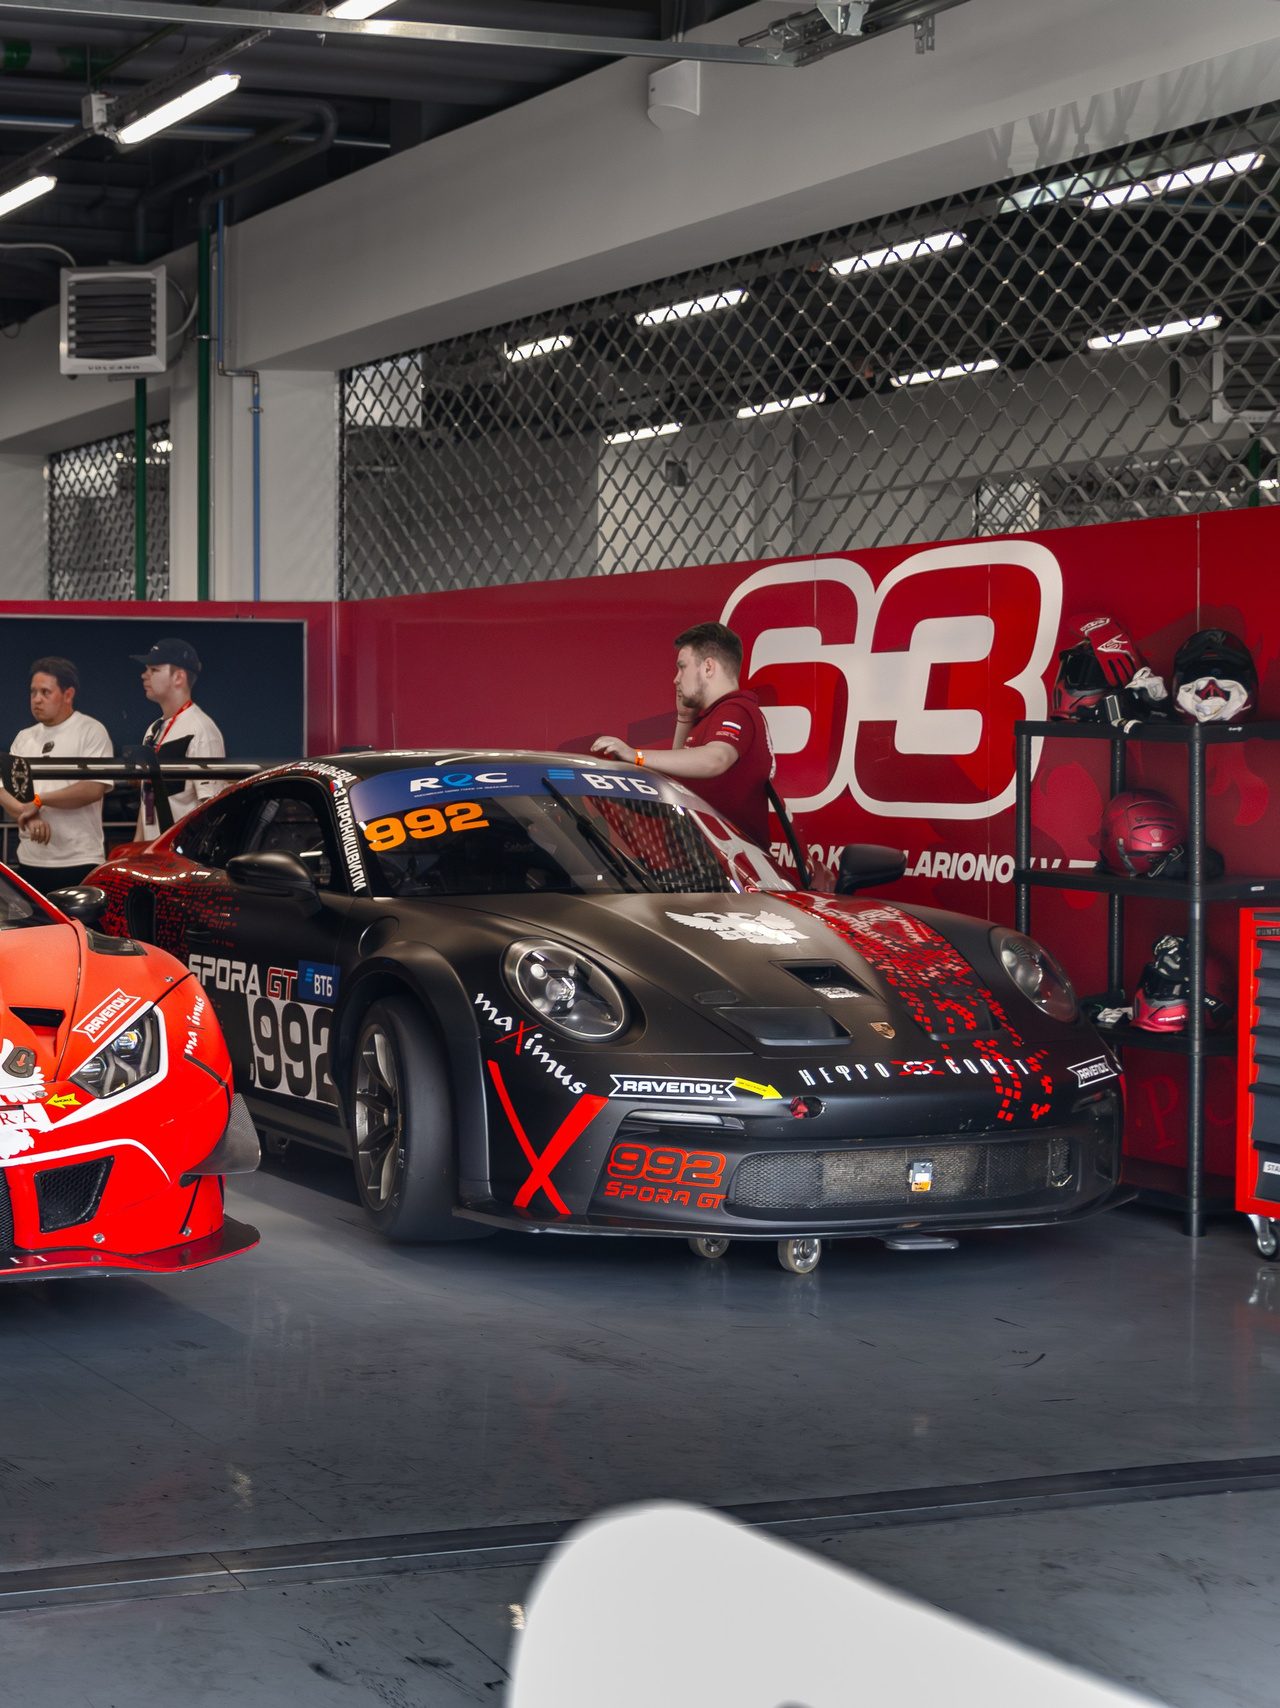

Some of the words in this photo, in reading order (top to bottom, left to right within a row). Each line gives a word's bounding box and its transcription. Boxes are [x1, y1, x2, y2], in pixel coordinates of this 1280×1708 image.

[719, 540, 1063, 820] 63
[363, 802, 491, 852] 992
[189, 954, 261, 996] SPORA
[266, 967, 298, 1000] GT
[87, 995, 130, 1035] RAVENOL
[622, 1081, 724, 1095] RAVENOL
[798, 1062, 891, 1086] НЕФРО
[607, 1142, 726, 1188] 992
[604, 1181, 689, 1206] SPORA
[697, 1193, 727, 1209] GT
